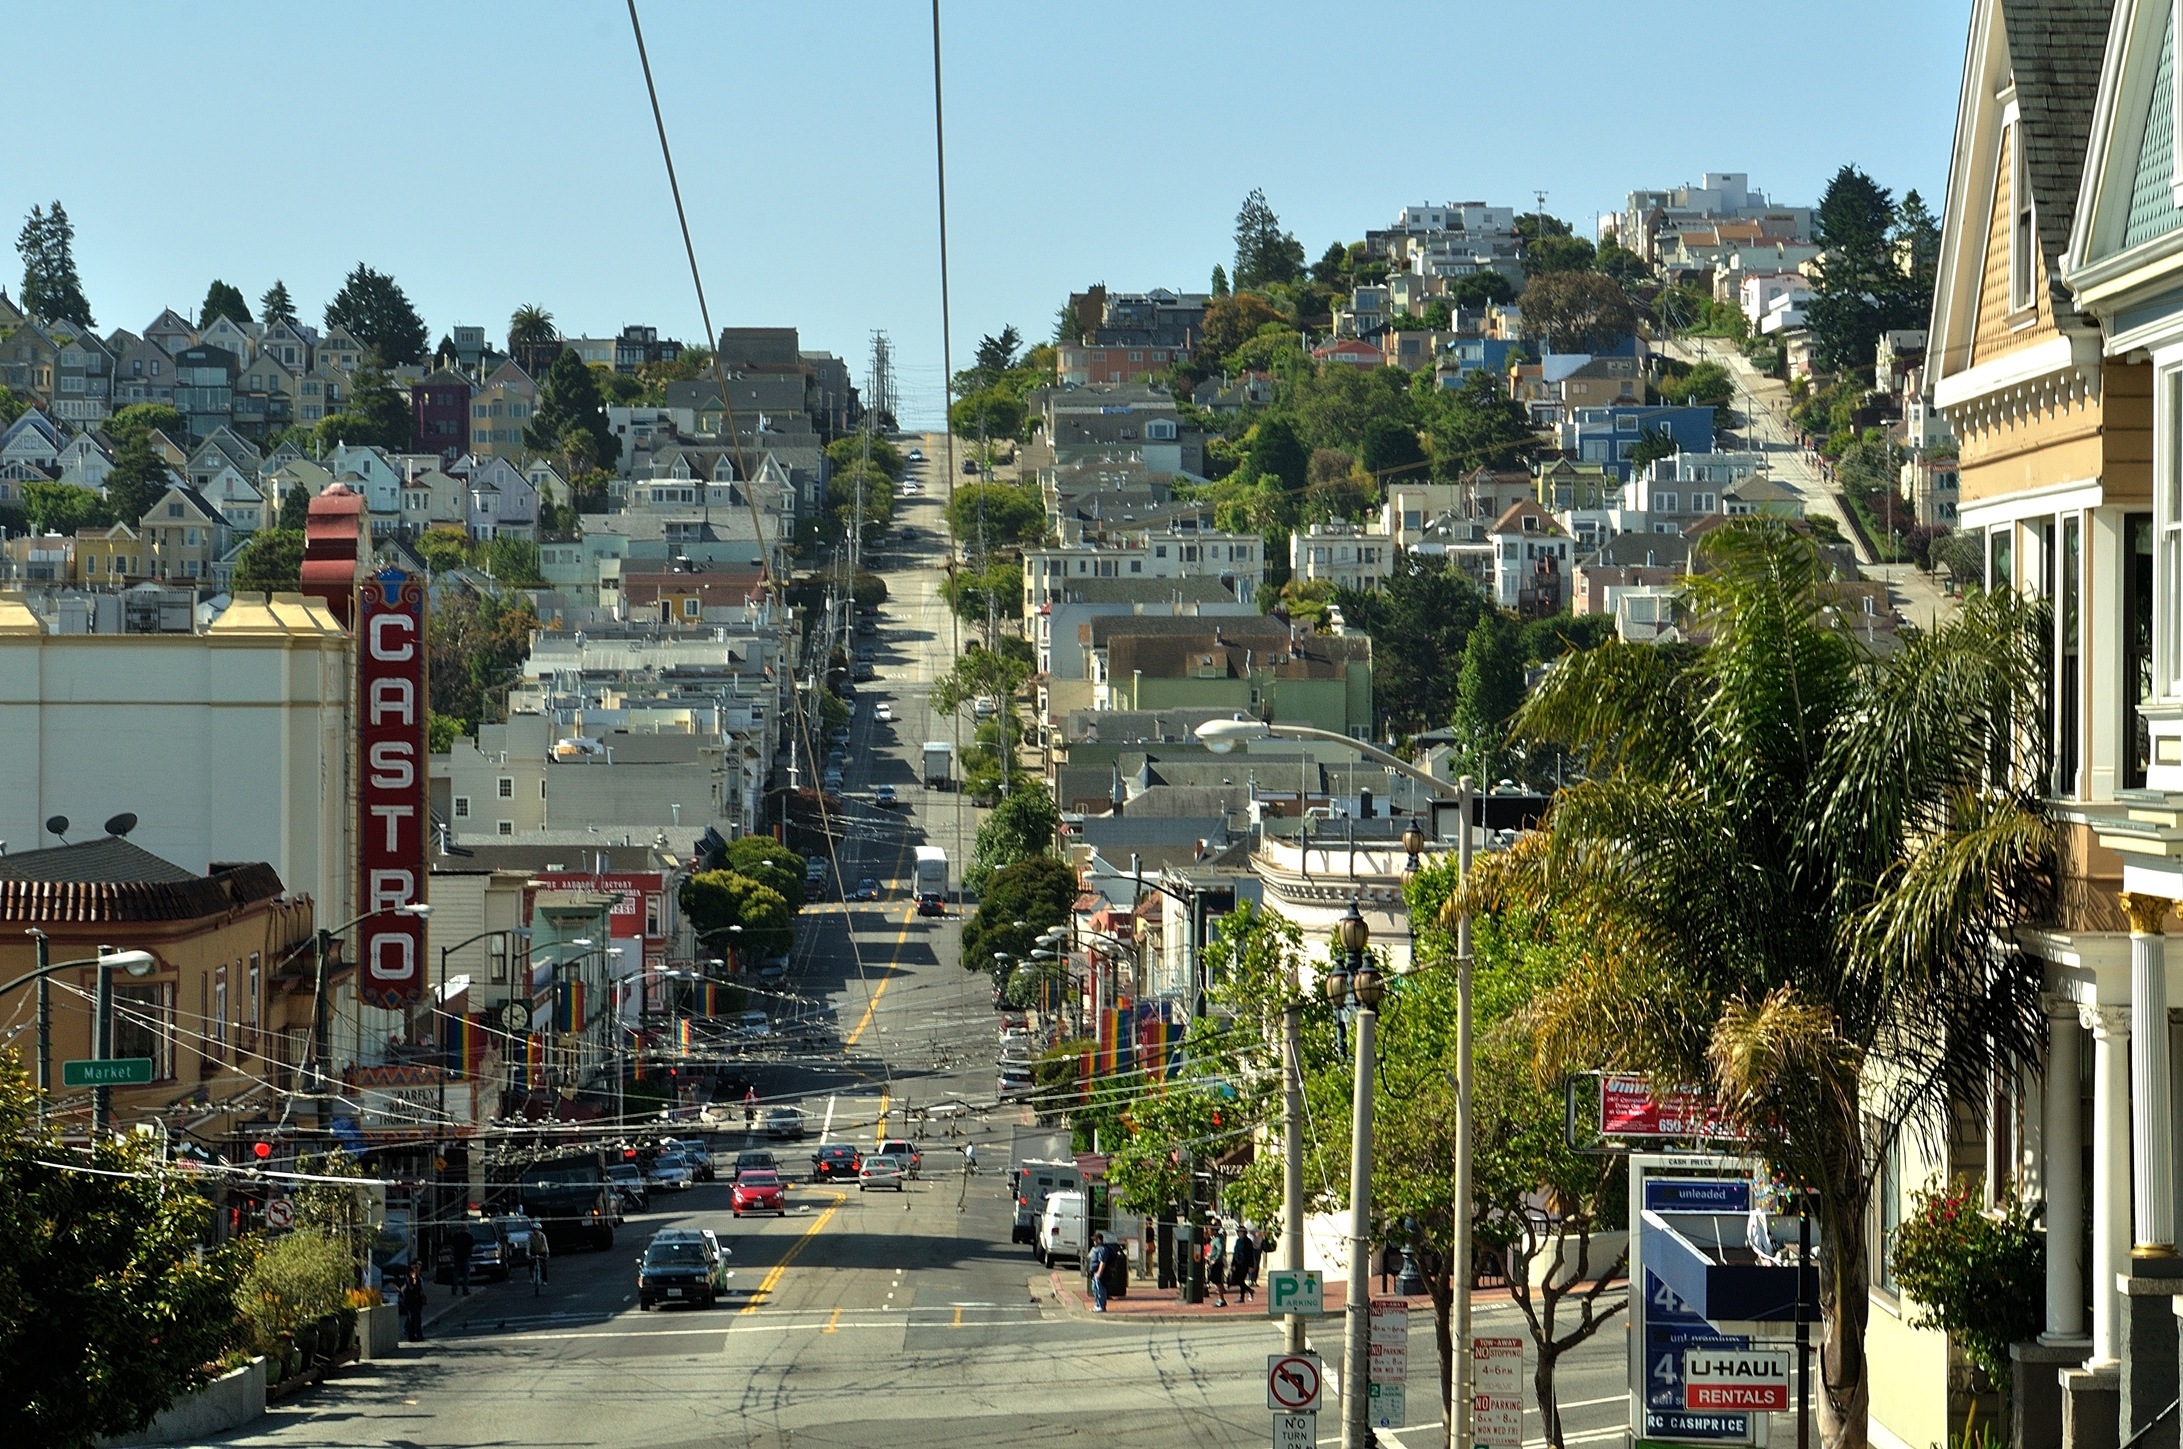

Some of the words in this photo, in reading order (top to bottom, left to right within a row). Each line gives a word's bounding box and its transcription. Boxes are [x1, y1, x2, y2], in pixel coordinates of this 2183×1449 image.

[369, 613, 415, 980] CASTRO
[84, 1065, 132, 1080] Market
[1669, 1158, 1686, 1166] CASH
[1679, 1188, 1726, 1199] unleaded
[1480, 1339, 1517, 1347] TOW-AWAY
[1371, 1345, 1382, 1355] NO
[1475, 1347, 1489, 1358] NO
[1490, 1349, 1521, 1358] STOPPING
[1691, 1360, 1784, 1376] U-HAUL
[1699, 1389, 1775, 1404] RENTALS
[1475, 1397, 1489, 1409] NO
[1490, 1400, 1521, 1411] PARKING
[1285, 1418, 1306, 1429] NO
[1282, 1431, 1308, 1441] TURN
[1477, 1426, 1491, 1435] MON
[1493, 1426, 1507, 1435] WED
[1508, 1426, 1519, 1435] FRI
